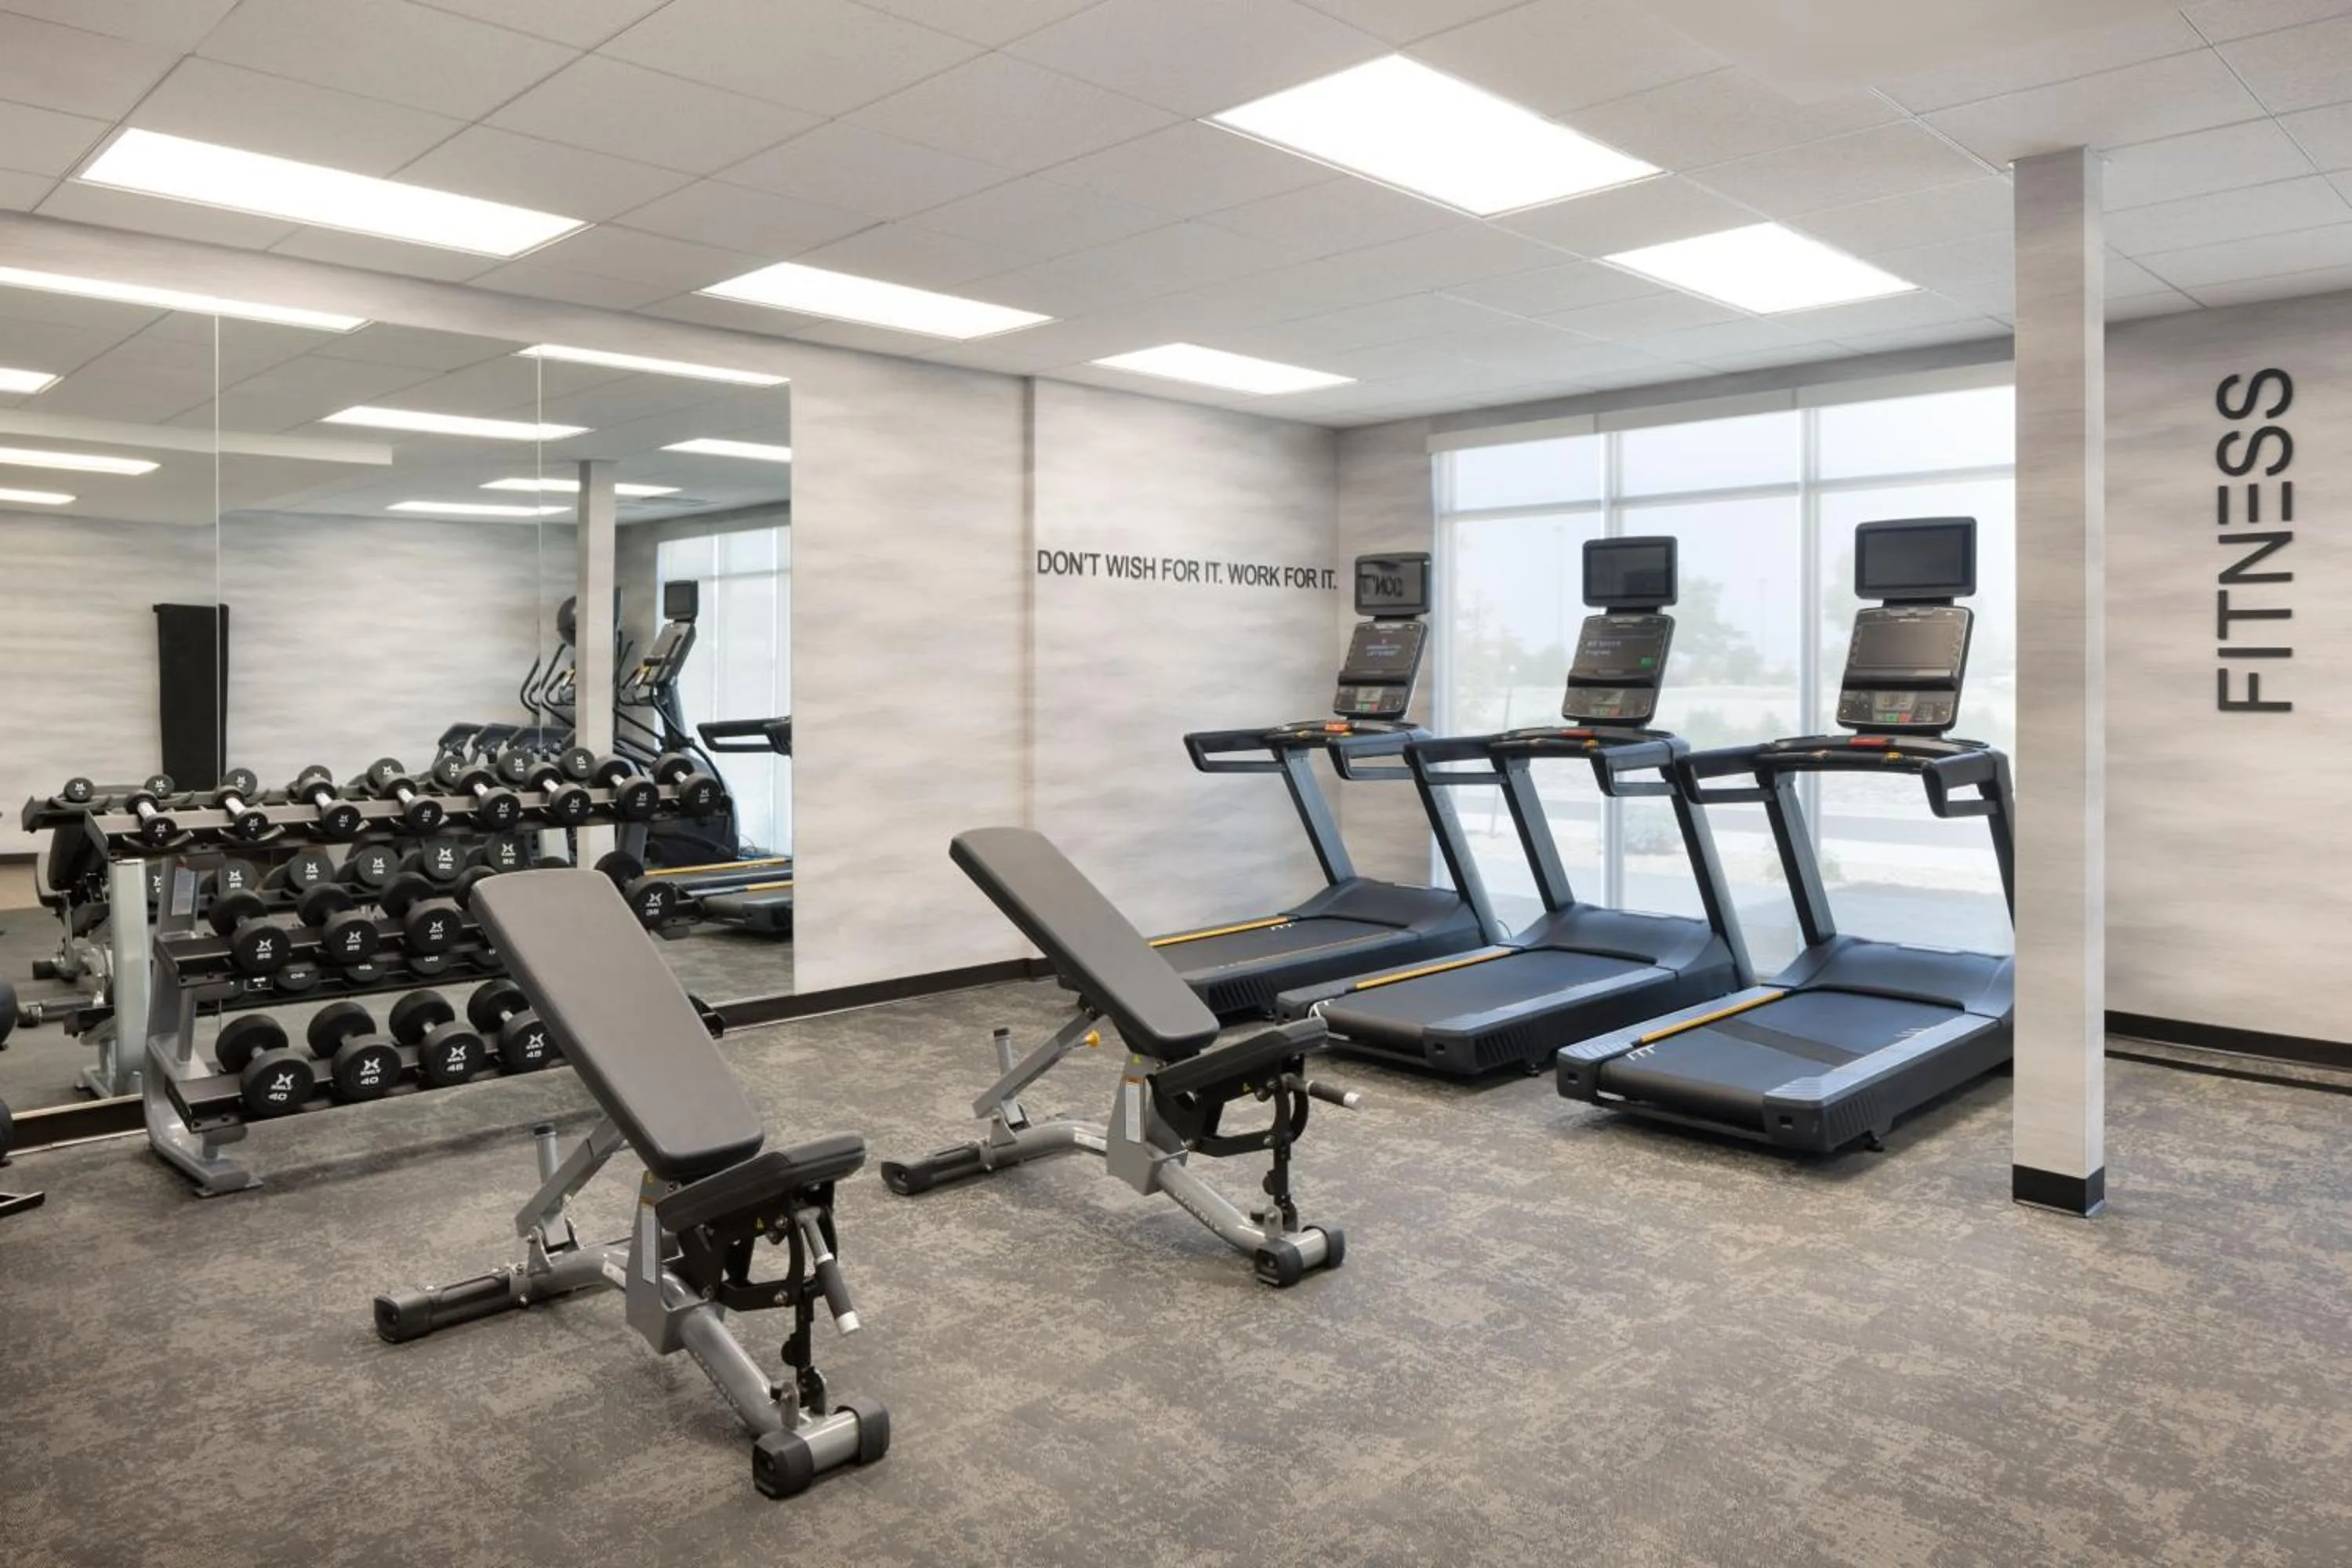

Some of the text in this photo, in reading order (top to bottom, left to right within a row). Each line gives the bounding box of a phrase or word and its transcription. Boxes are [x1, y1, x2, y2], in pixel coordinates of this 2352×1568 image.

[2216, 368, 2293, 712] FITNESS
[1037, 550, 1338, 590] DON'T WISH FOR IT. WORK FOR IT.
[360, 1076, 379, 1085] 40
[268, 1092, 288, 1101] 40
